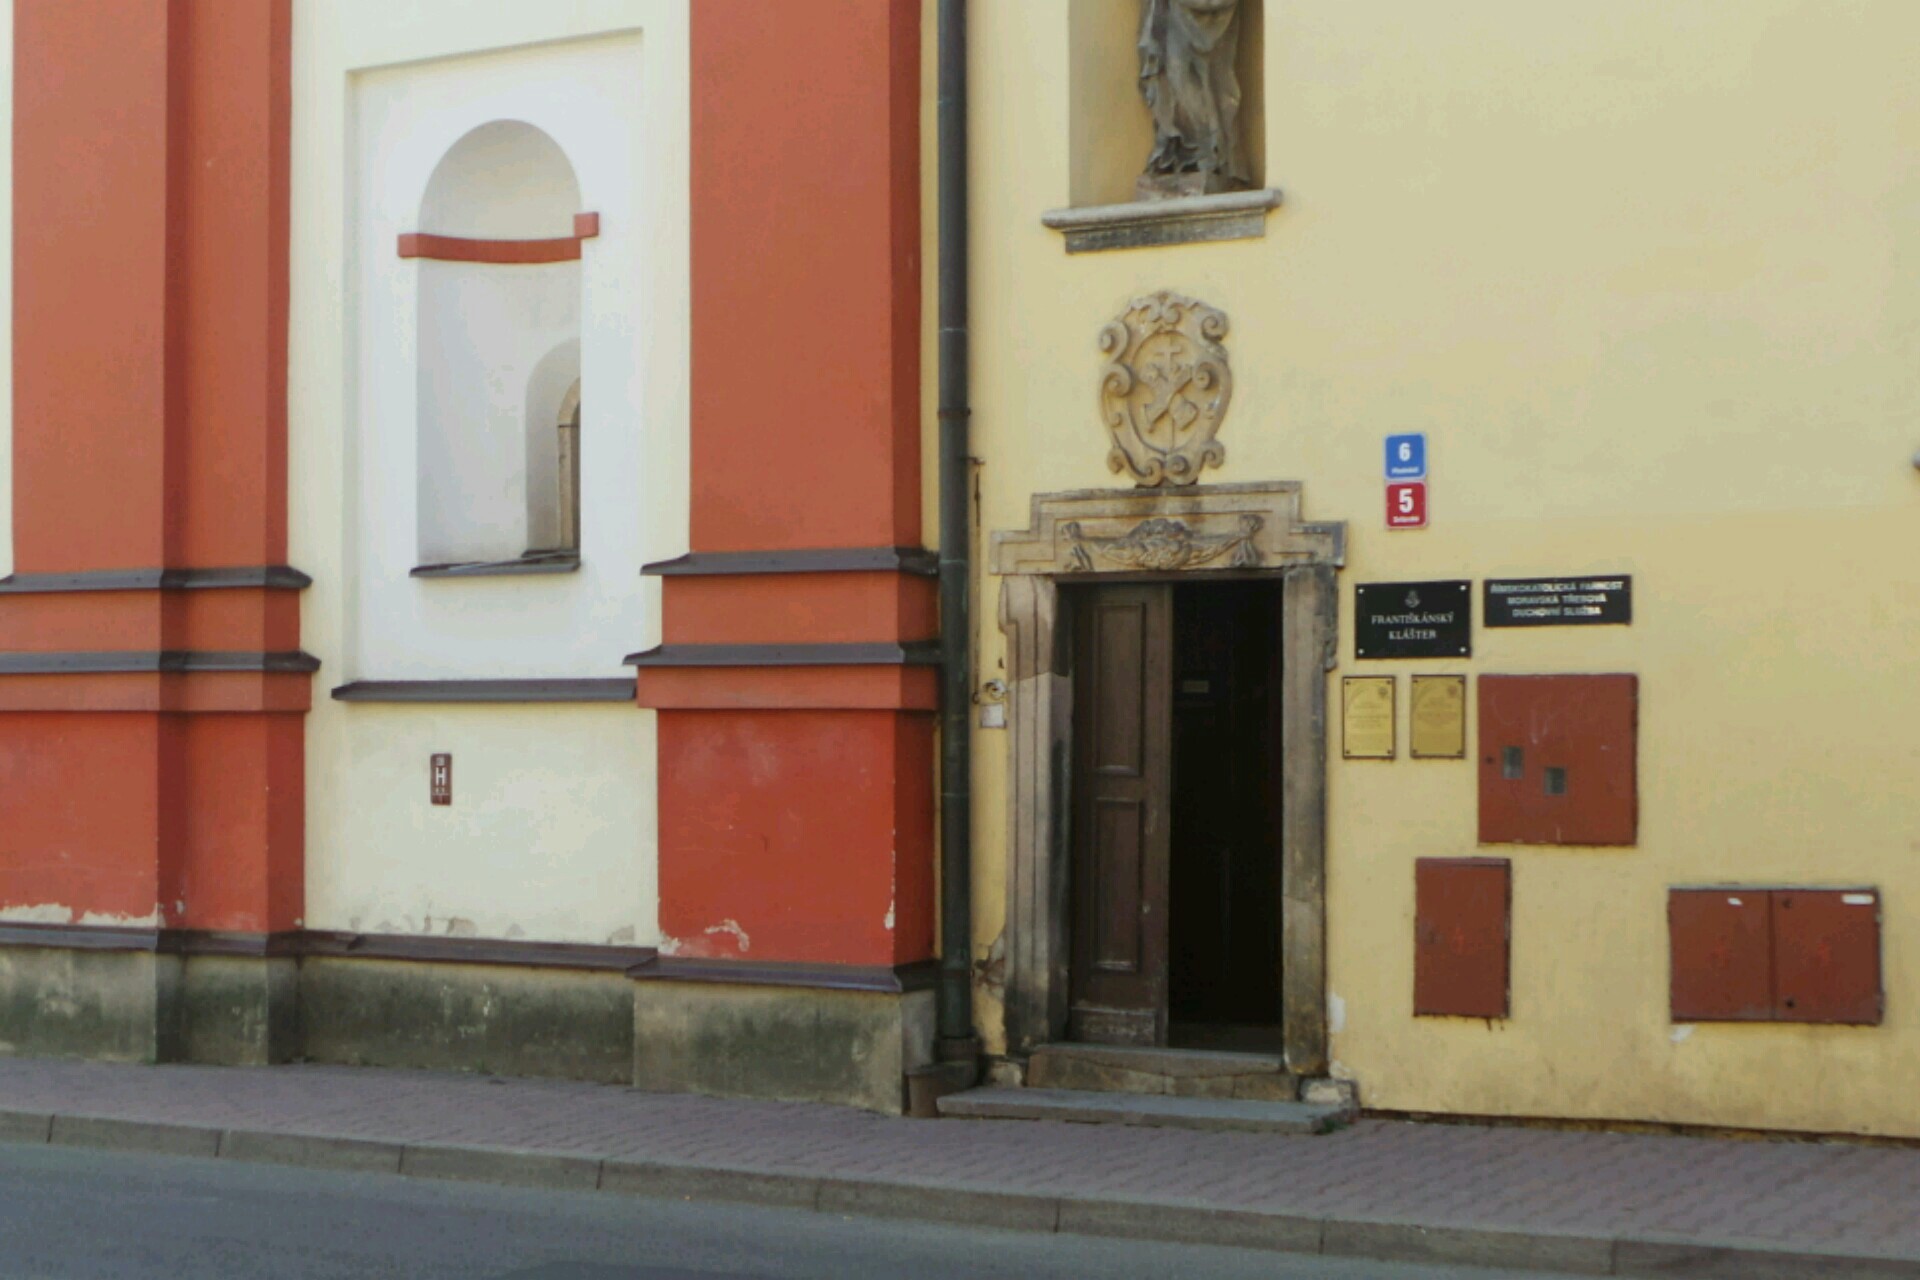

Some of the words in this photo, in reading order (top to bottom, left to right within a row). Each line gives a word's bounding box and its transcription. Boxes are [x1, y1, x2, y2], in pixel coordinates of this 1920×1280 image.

[1399, 442, 1411, 462] 6
[1398, 488, 1414, 513] 5
[1371, 611, 1454, 625] FRANTIŠKÁNSKÝ
[1388, 627, 1437, 640] KLÁŠTER
[435, 766, 446, 787] H
